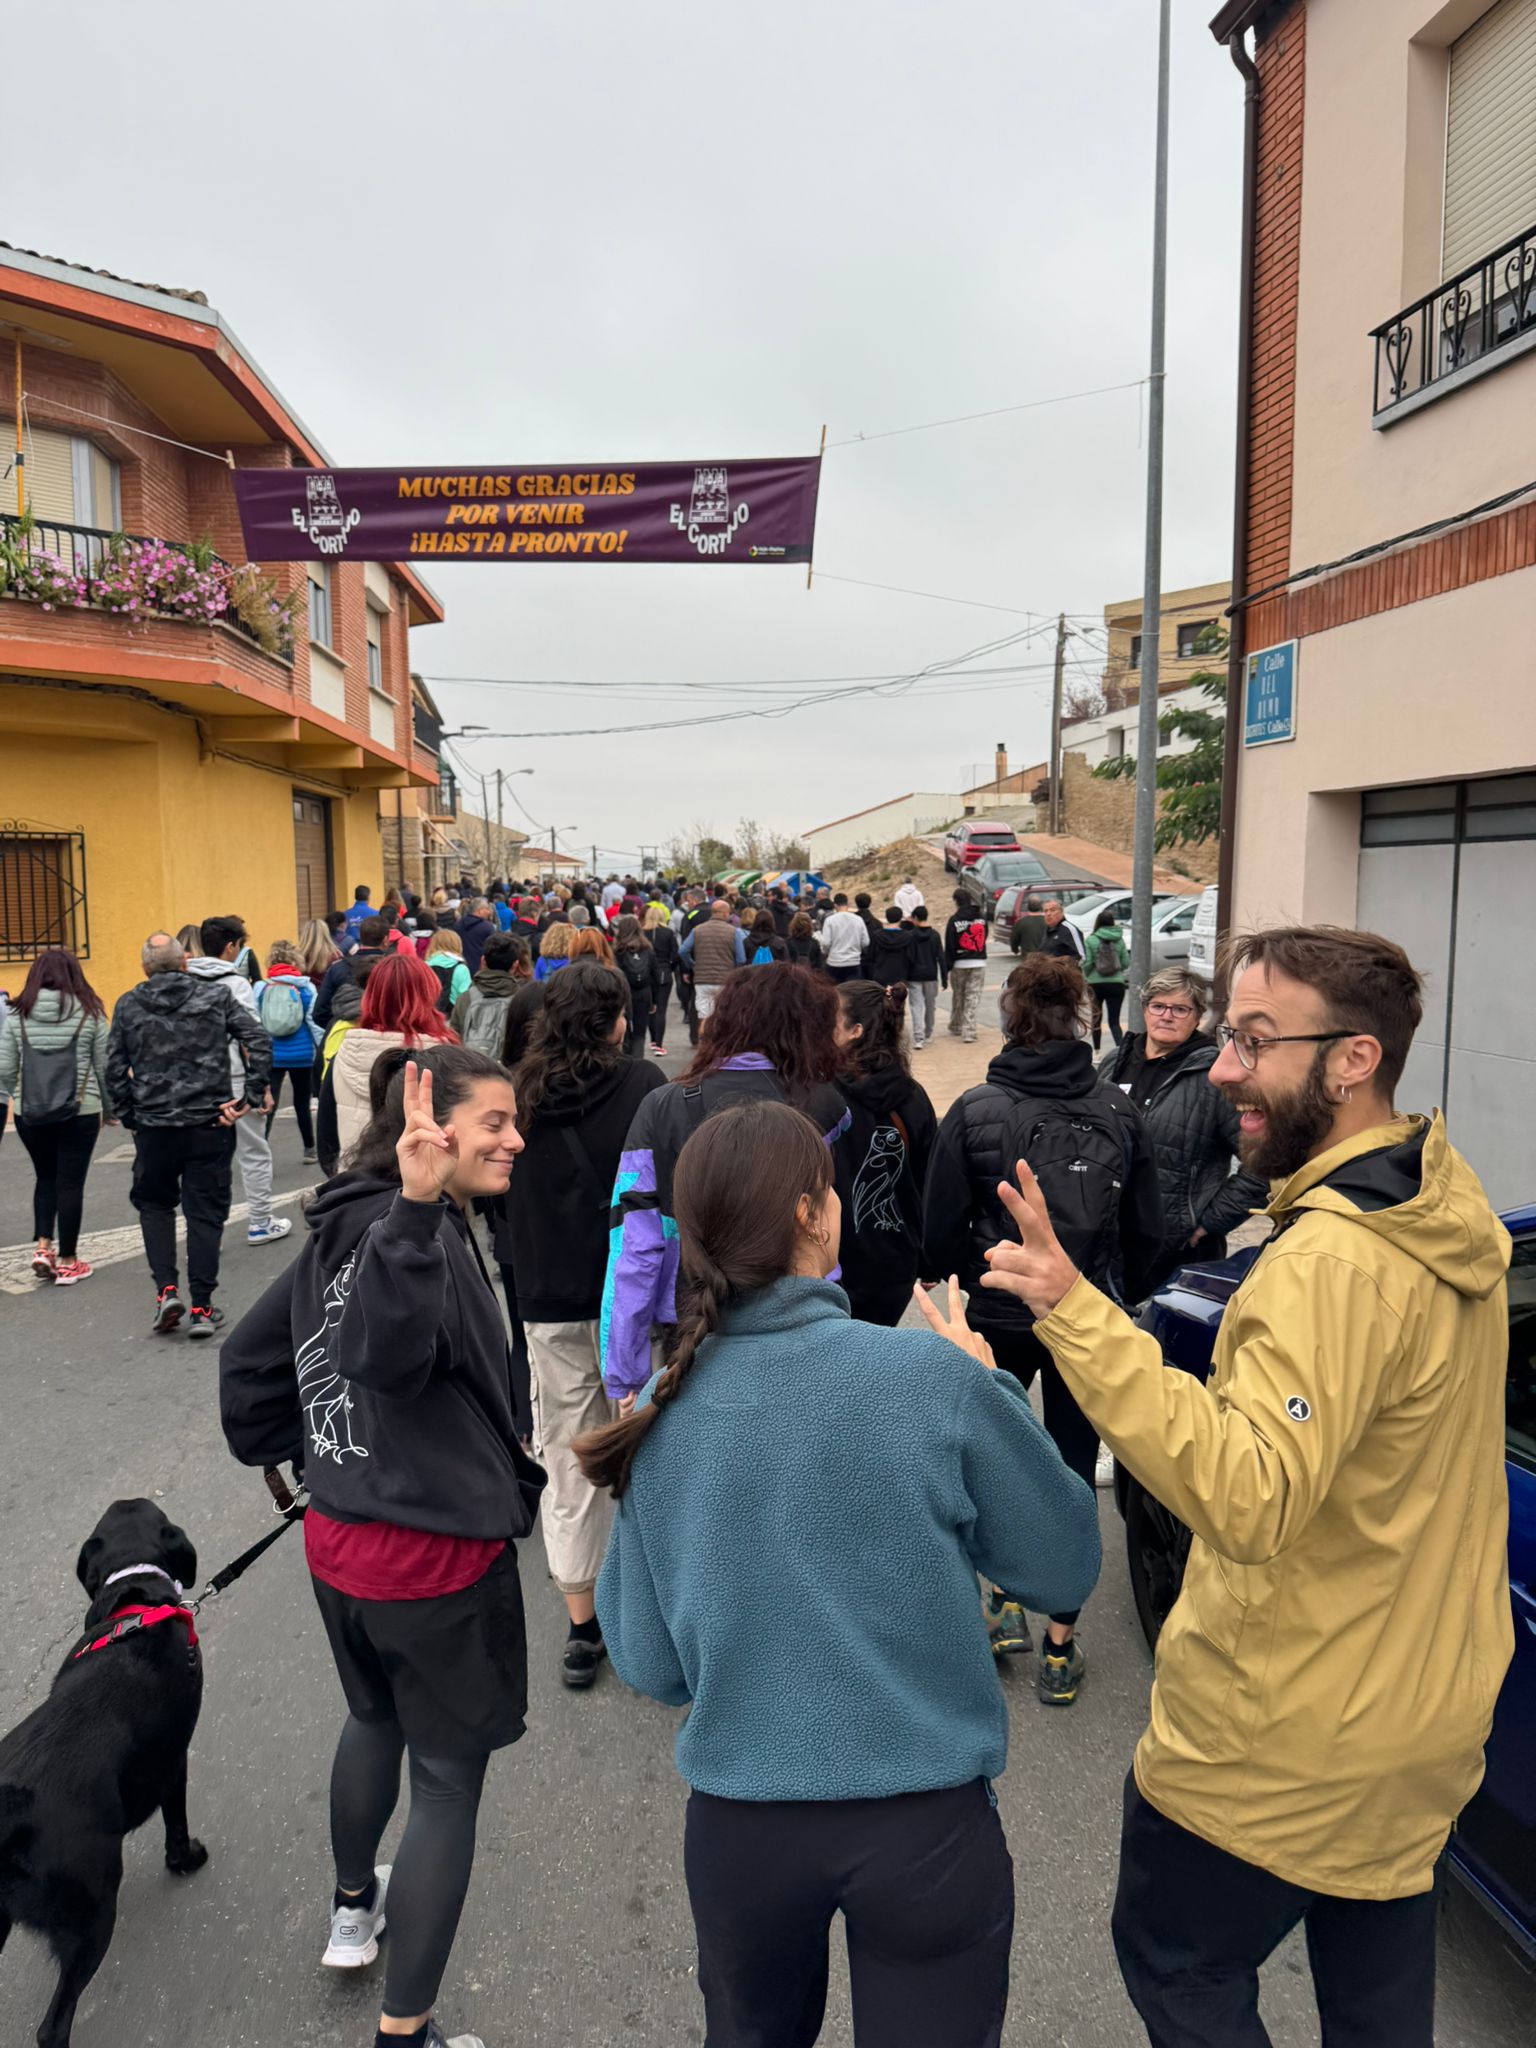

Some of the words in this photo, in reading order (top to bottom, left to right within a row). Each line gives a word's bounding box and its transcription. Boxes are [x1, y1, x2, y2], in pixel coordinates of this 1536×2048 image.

[398, 475, 512, 498] MUCHAS
[516, 473, 635, 497] GRACIAS
[445, 503, 500, 525] POR
[505, 502, 585, 525] VENIR
[291, 508, 309, 533] EL
[308, 508, 361, 554] CORTIJO
[669, 504, 687, 531] EL
[687, 502, 749, 555] CORTIJO
[409, 532, 506, 553] ¡HASTA
[508, 530, 629, 554] PRONTO!
[1264, 653, 1285, 672] Calle
